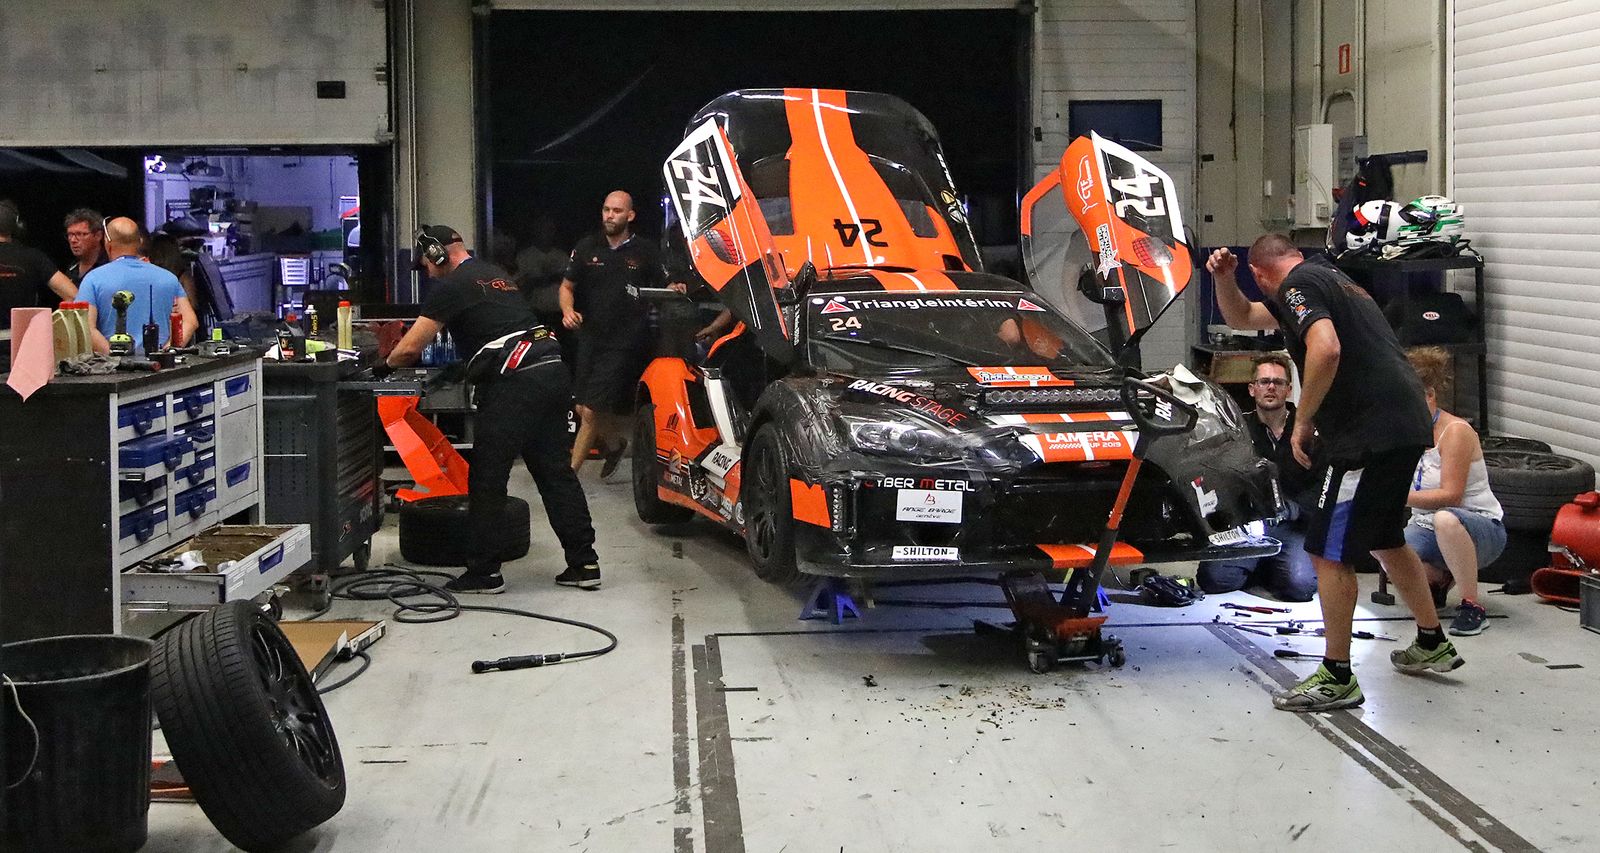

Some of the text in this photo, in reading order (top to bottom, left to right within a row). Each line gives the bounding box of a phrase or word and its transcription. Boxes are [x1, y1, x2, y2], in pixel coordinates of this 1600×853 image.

[671, 159, 728, 209] 24
[1110, 174, 1166, 218] 24
[833, 218, 889, 248] 24
[849, 297, 1014, 311] Triangleintérim
[828, 316, 862, 332] 24
[847, 380, 967, 427] RACING STAGE
[1045, 431, 1120, 443] LAMERA
[711, 451, 732, 471] RACING
[903, 547, 948, 556] SHILTON
